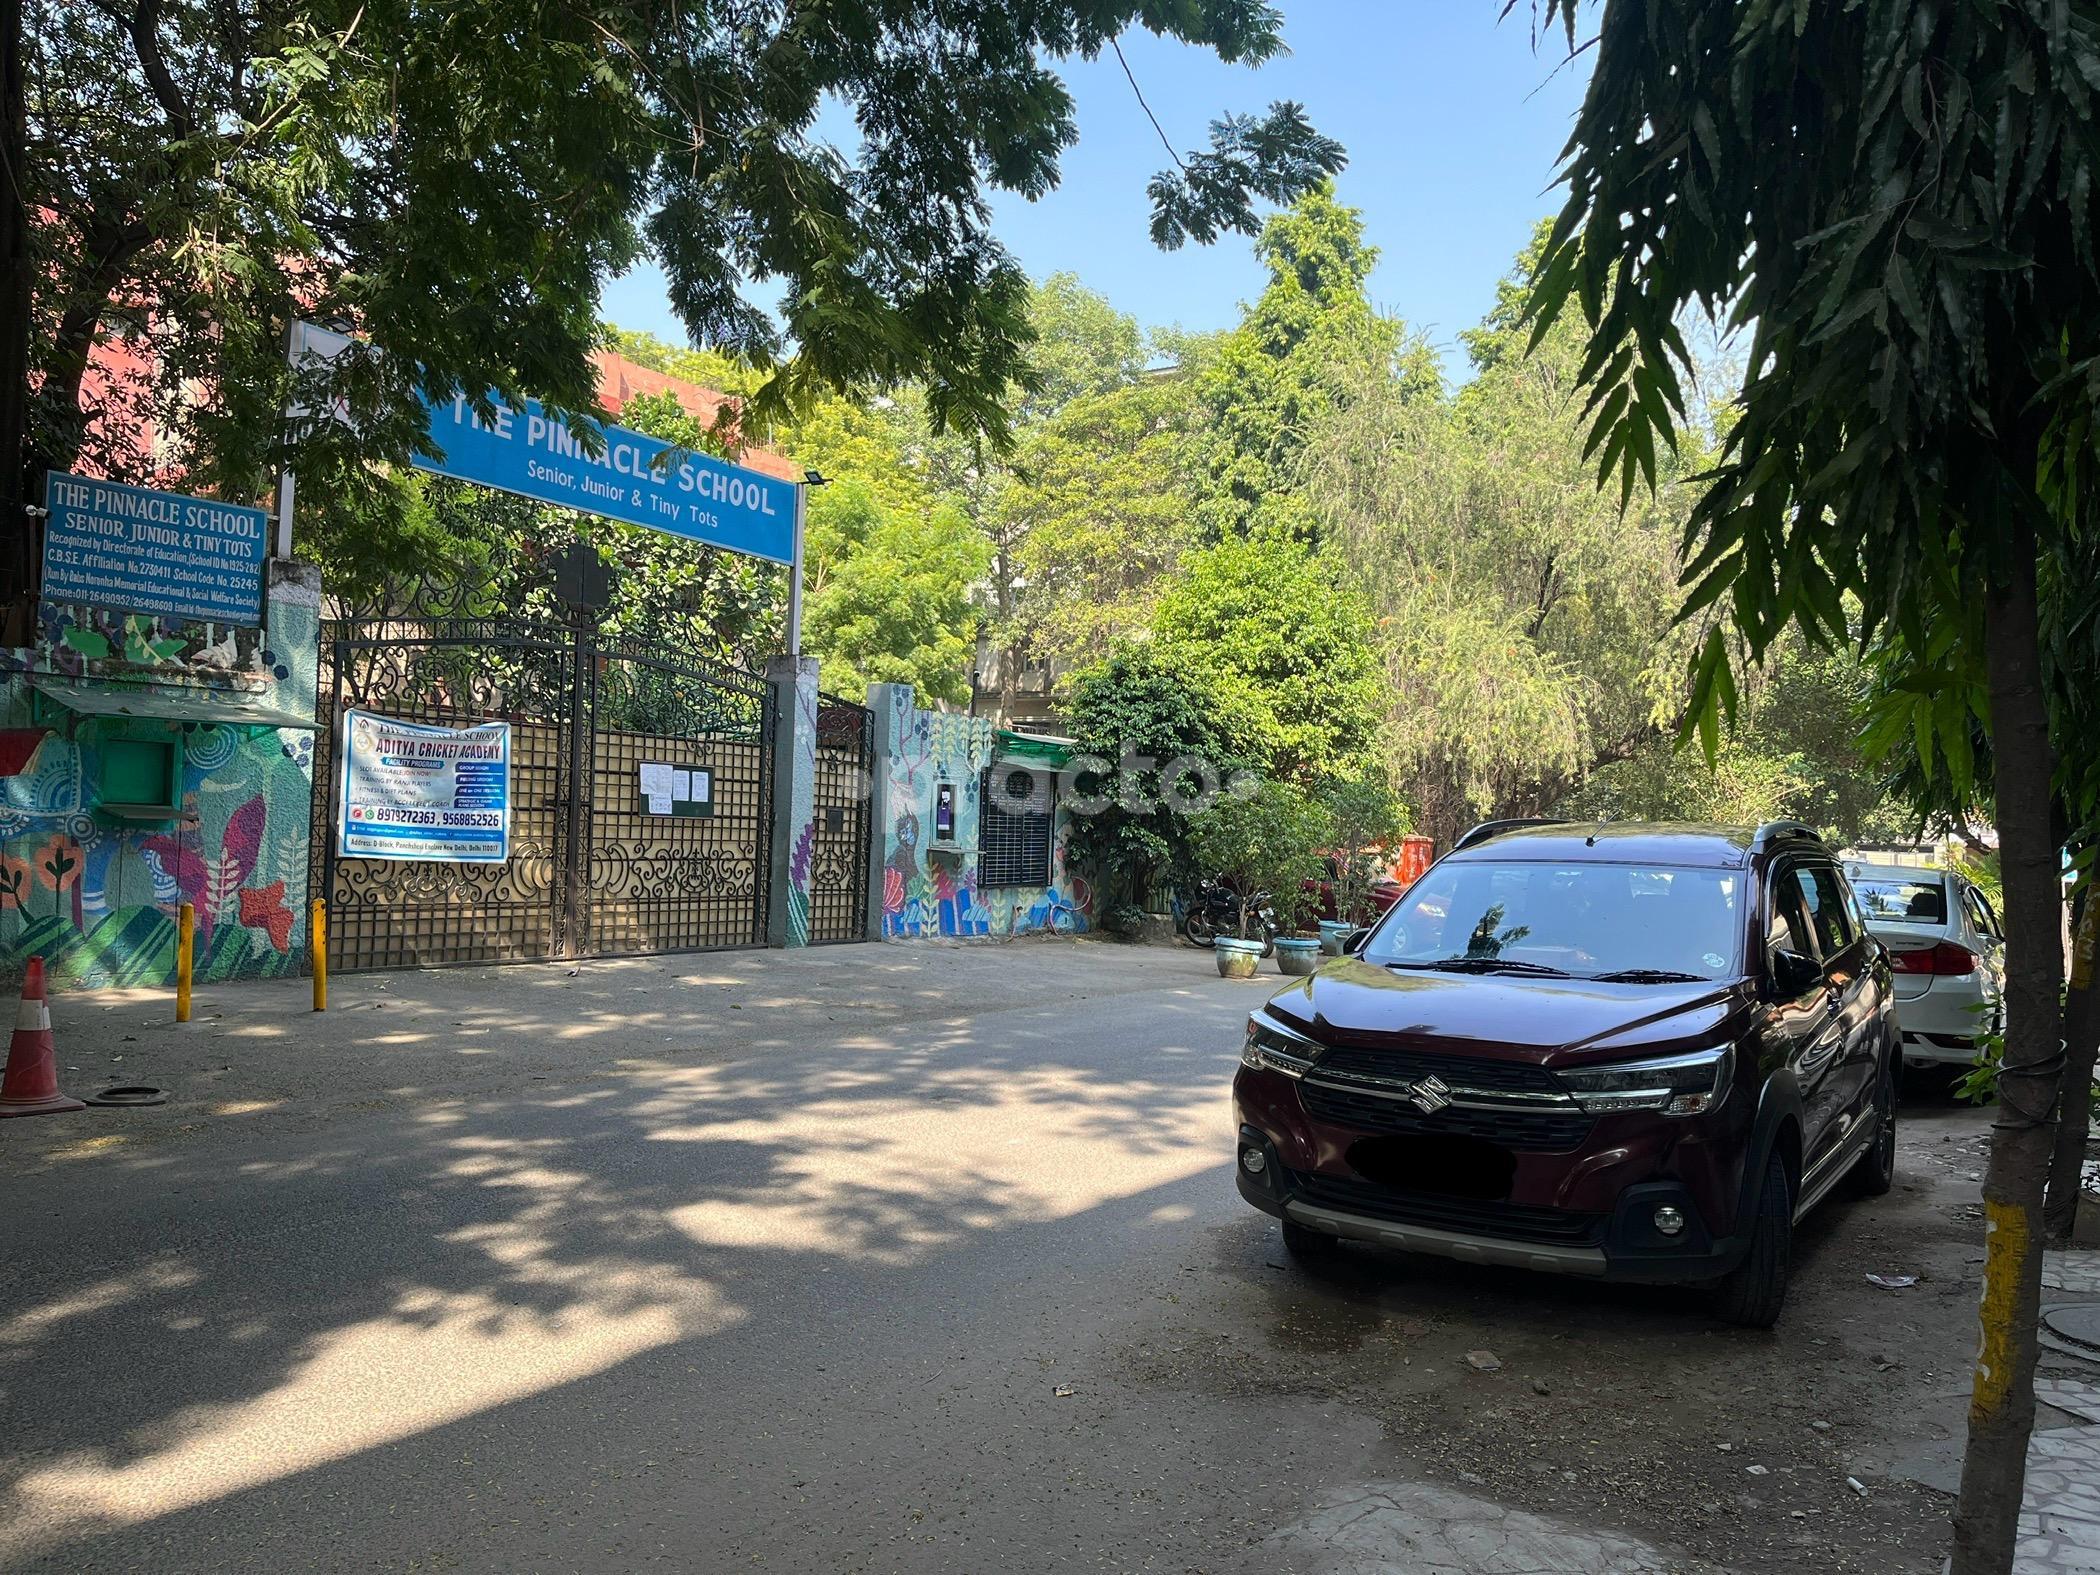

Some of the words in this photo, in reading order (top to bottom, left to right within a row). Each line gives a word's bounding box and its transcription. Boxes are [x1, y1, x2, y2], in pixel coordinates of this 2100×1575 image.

[527, 459, 577, 490] Senior,
[580, 475, 625, 502] Junior
[631, 489, 642, 507] &
[650, 494, 680, 521] Tiny
[689, 505, 718, 528] Tots
[678, 464, 775, 516] SCHOOL
[53, 481, 89, 510] THE
[94, 488, 180, 525] PINNACLE
[185, 506, 260, 539] SCHOOL
[49, 531, 92, 549] Recognized
[93, 538, 102, 552] by
[103, 539, 144, 557] Directorate
[146, 548, 153, 559] of
[65, 512, 128, 539] SENIOR,
[129, 523, 180, 547] JUNIOR
[182, 533, 192, 549] &
[194, 534, 221, 553] TINY
[223, 539, 252, 558] TOTS
[60, 568, 69, 585] By
[114, 577, 147, 592] Memorial
[147, 581, 184, 598] Educational
[191, 587, 209, 600] Social
[210, 590, 235, 605] Welfare
[82, 554, 125, 572] Affiliation
[173, 567, 197, 582] School
[198, 572, 214, 585] Code
[230, 577, 258, 591] 25245
[376, 738, 415, 757] ADITYA
[418, 742, 459, 759] CRICKET
[459, 745, 500, 759] ACADEMY
[377, 808, 435, 824] 8979272363
[442, 812, 499, 827] 9568852526
